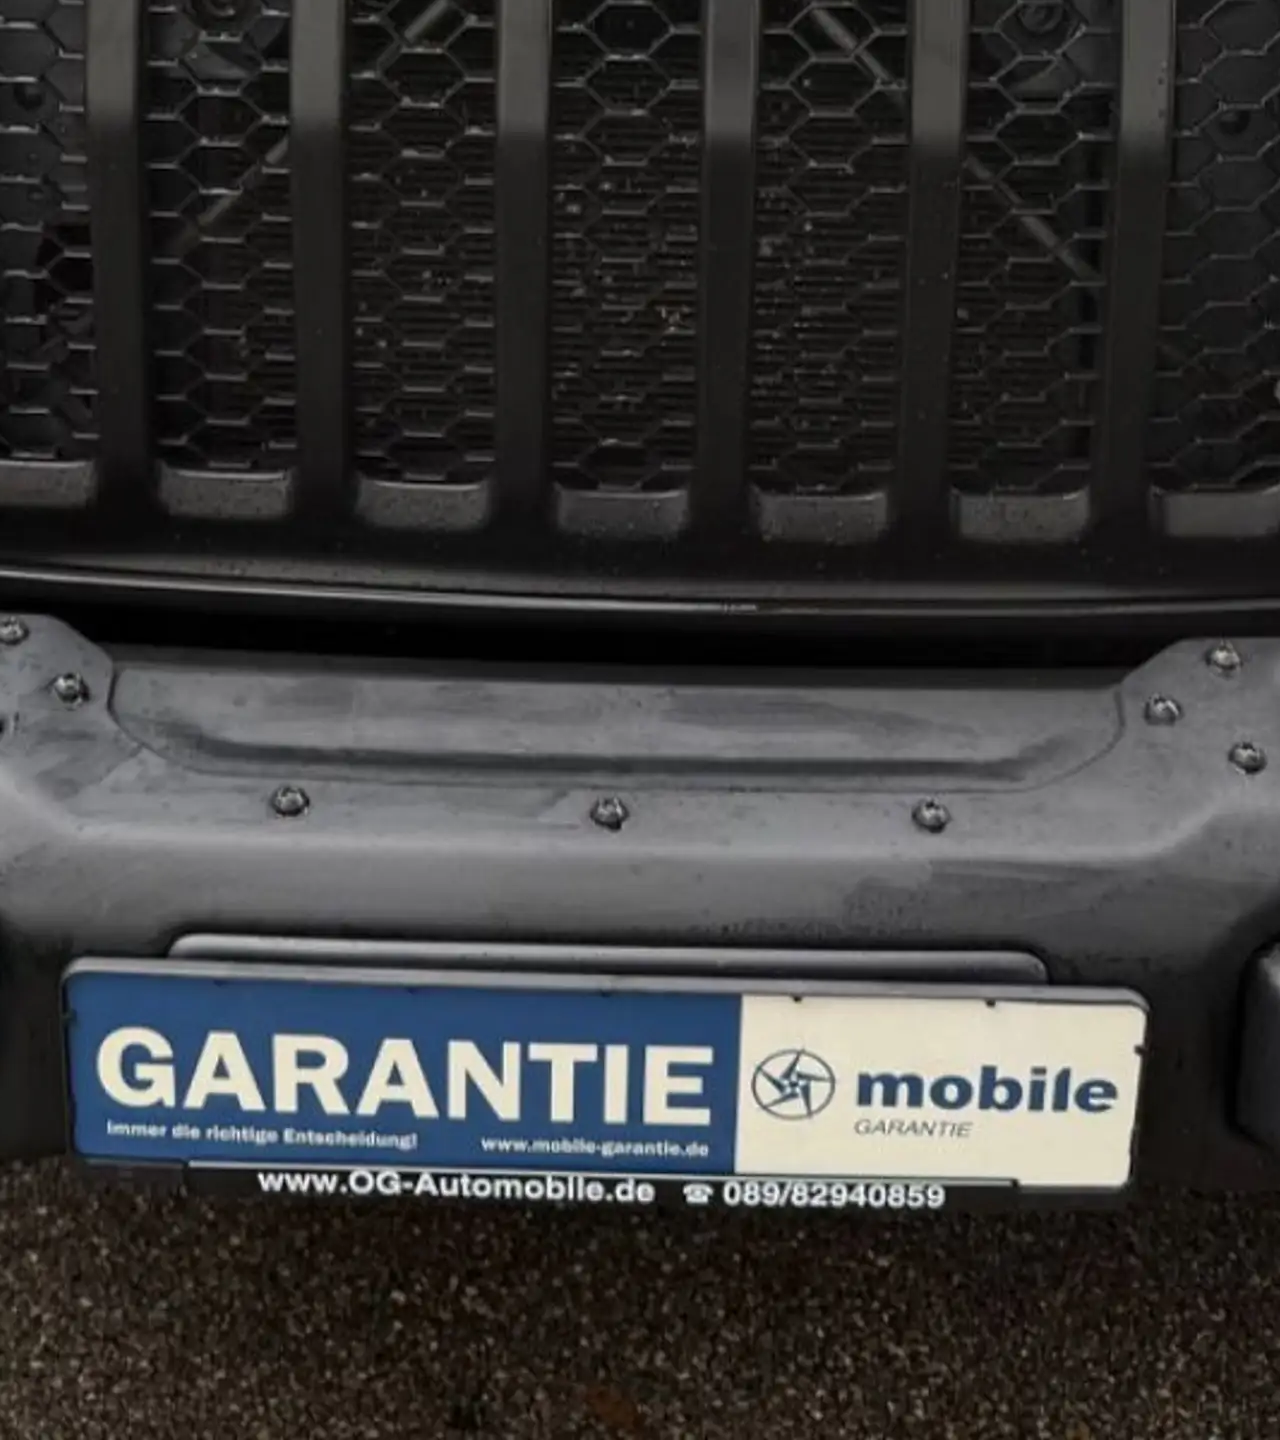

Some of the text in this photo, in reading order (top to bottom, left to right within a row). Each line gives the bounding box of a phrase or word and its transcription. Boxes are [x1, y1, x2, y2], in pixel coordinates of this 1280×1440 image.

[96, 1026, 714, 1126] GARANTIE
[856, 1065, 1119, 1113] mobile
[106, 1119, 418, 1152] Immer die richtige Entscheidung!
[853, 1117, 973, 1139] GARANTIE
[480, 1136, 710, 1158] www.mobile-garantie.de
[257, 1170, 946, 1209] www.OG-Automobile.de 089/82940859
